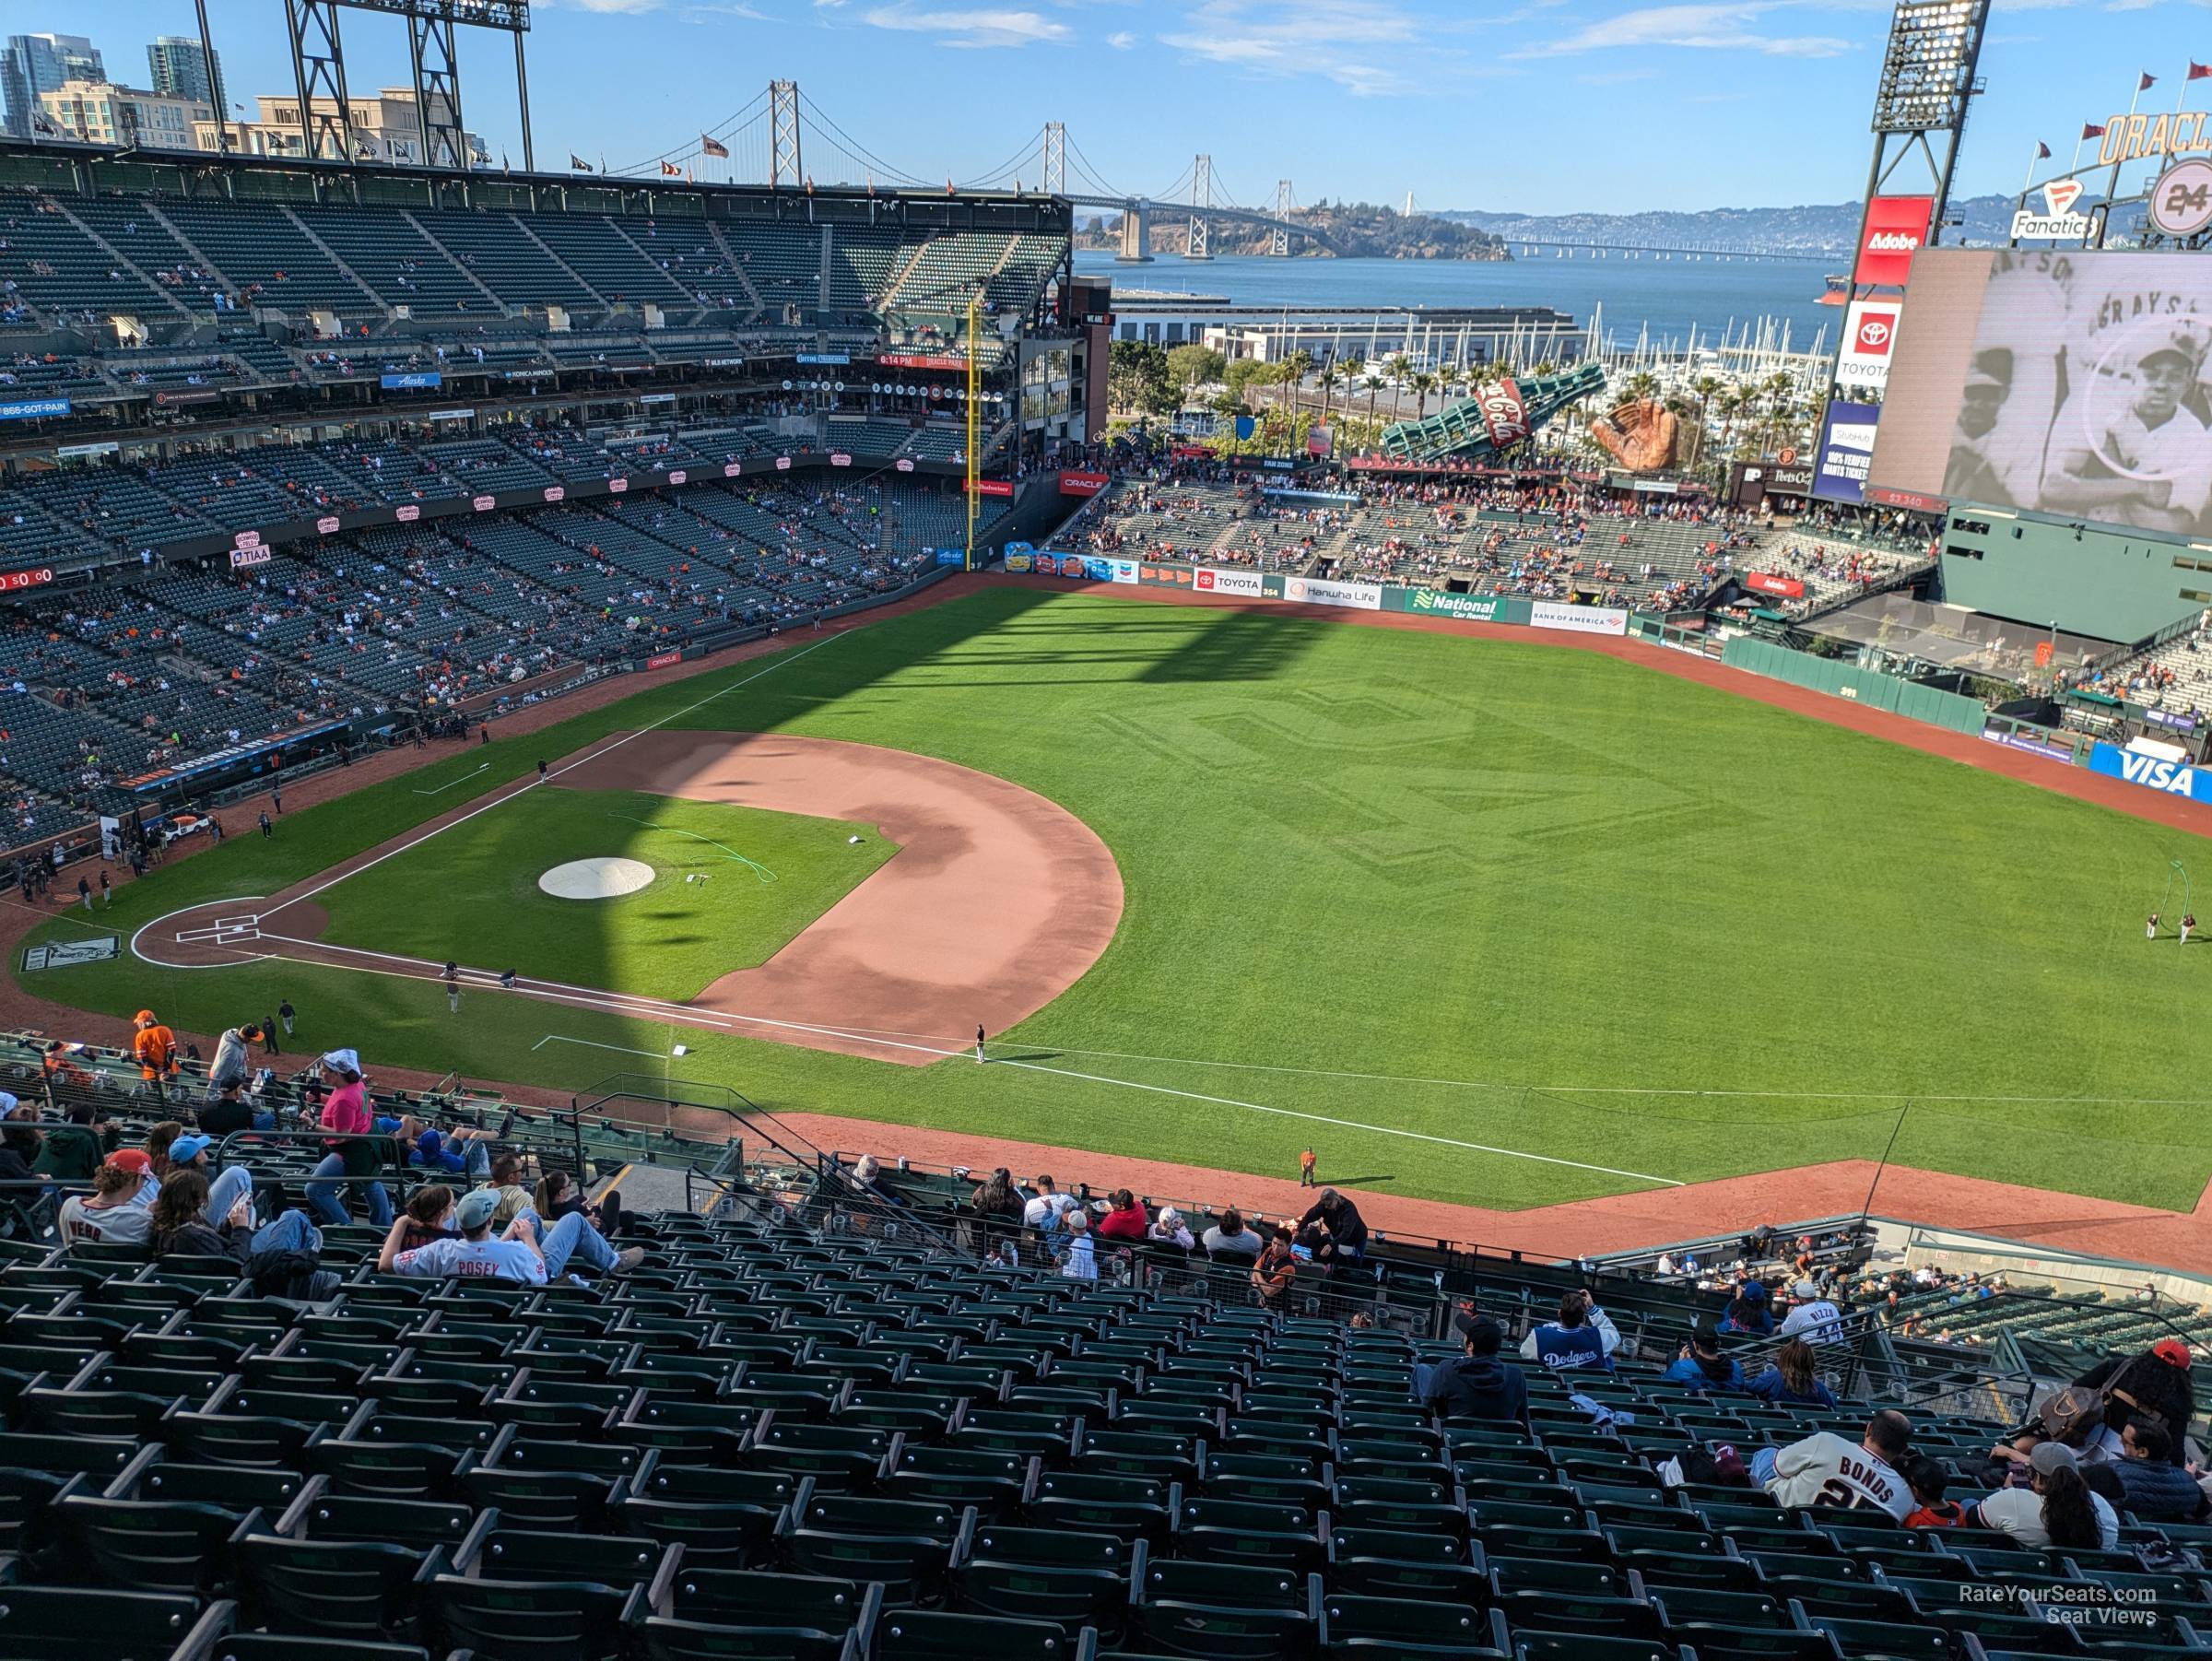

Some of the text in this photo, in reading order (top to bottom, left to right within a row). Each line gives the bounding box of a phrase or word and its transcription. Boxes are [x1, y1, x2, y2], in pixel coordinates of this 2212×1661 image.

[2099, 112, 2212, 165] ORACL
[2166, 184, 2208, 217] 24
[2016, 215, 2096, 235] Fanatics
[1868, 232, 1918, 251] Adobe
[880, 355, 912, 366] 6:14 PM
[397, 374, 426, 385] Alaska
[532, 369, 555, 377] MINOLTA
[1836, 429, 1871, 443] StubHub
[1277, 461, 1294, 469] ZONE
[1822, 463, 1844, 477] GIANTS
[1065, 478, 1103, 489] ORACLE
[243, 548, 269, 562] TIAA
[1218, 577, 1259, 590] TOYOTA
[1764, 578, 1787, 591] Adobe
[1263, 588, 1277, 596] 354
[1307, 586, 1375, 603] Hanwha Life
[1432, 595, 1496, 614] National
[1453, 610, 1492, 621] Car Rental
[1534, 612, 1606, 626] BANK OF AMERICA
[652, 654, 677, 666] ORACLE
[246, 738, 271, 749] SAN
[171, 746, 245, 771] FRANCISCO
[2118, 749, 2194, 796] VISA
[458, 1260, 500, 1277] POSEY
[1809, 1308, 1834, 1323] RIZZO
[1544, 1349, 1597, 1367] Dodgers
[1839, 1455, 1895, 1503] BONDS
